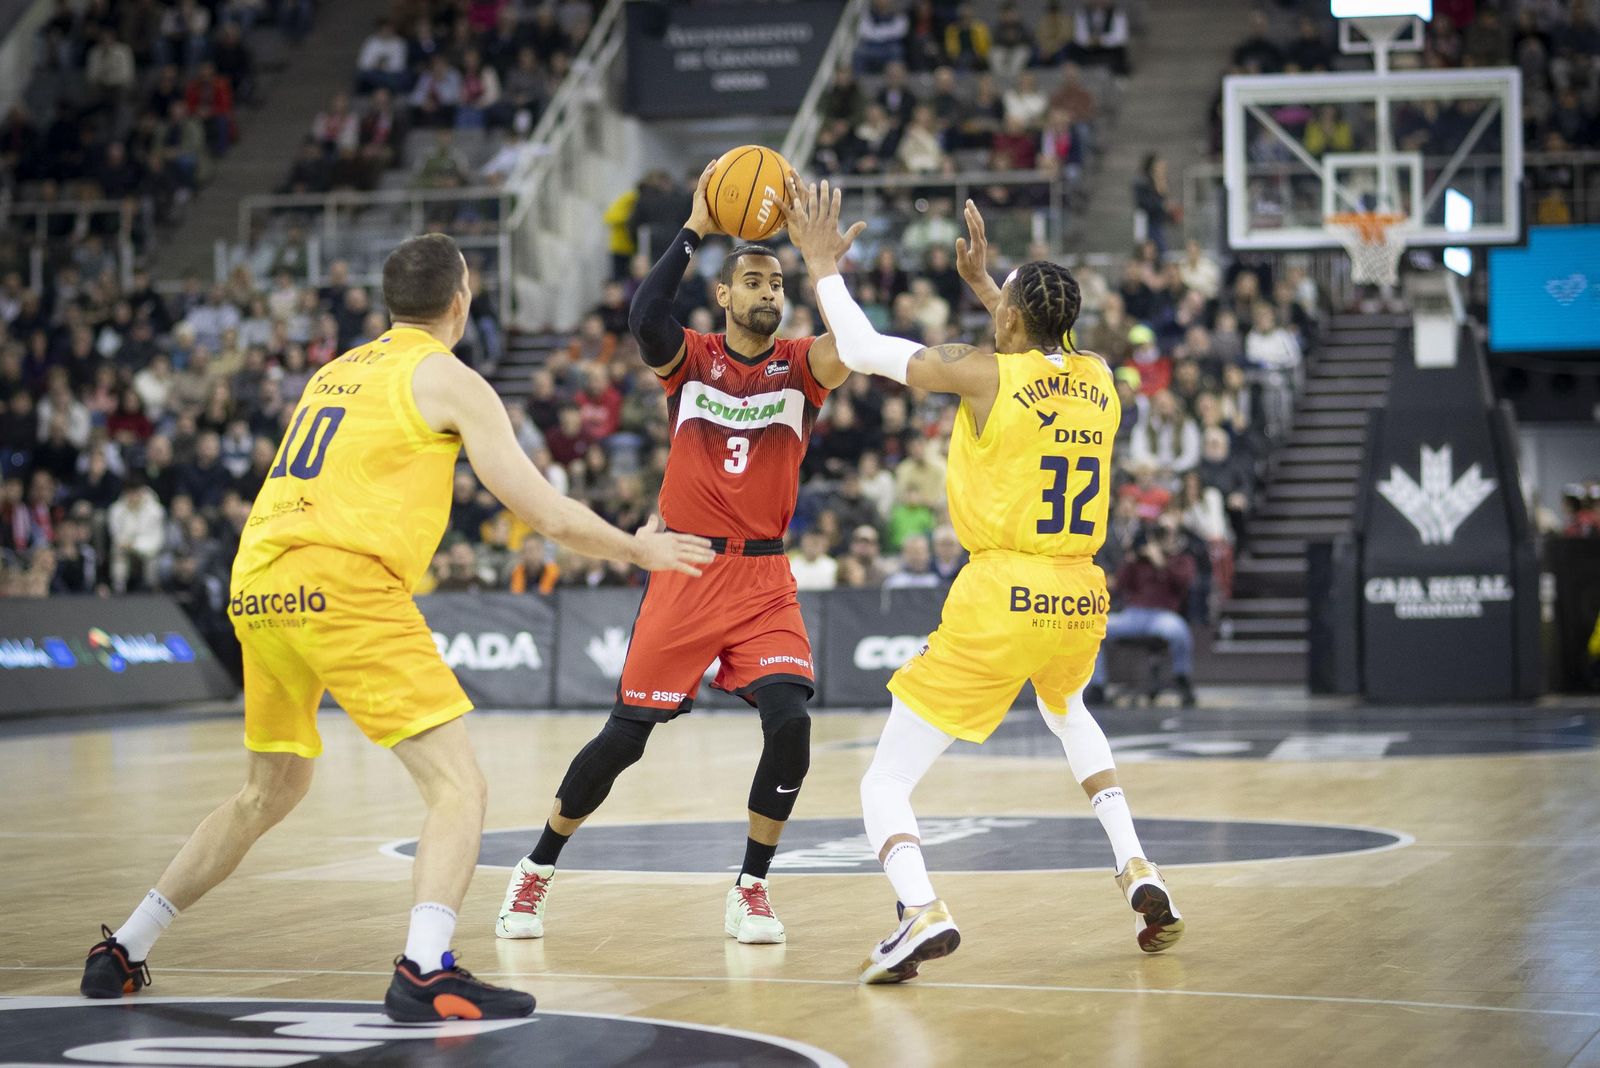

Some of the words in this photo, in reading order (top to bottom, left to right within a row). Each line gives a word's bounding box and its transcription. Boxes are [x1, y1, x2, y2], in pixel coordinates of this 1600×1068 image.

[1012, 375, 1109, 412] THOMASSON
[270, 406, 346, 480] 10
[723, 436, 750, 474] 3
[1036, 455, 1101, 536] 32
[1010, 586, 1106, 616] Barceló
[1032, 618, 1062, 630] HOTEL
[1067, 620, 1095, 630] GROUP
[767, 655, 809, 668] BERNER
[625, 689, 647, 699] vive
